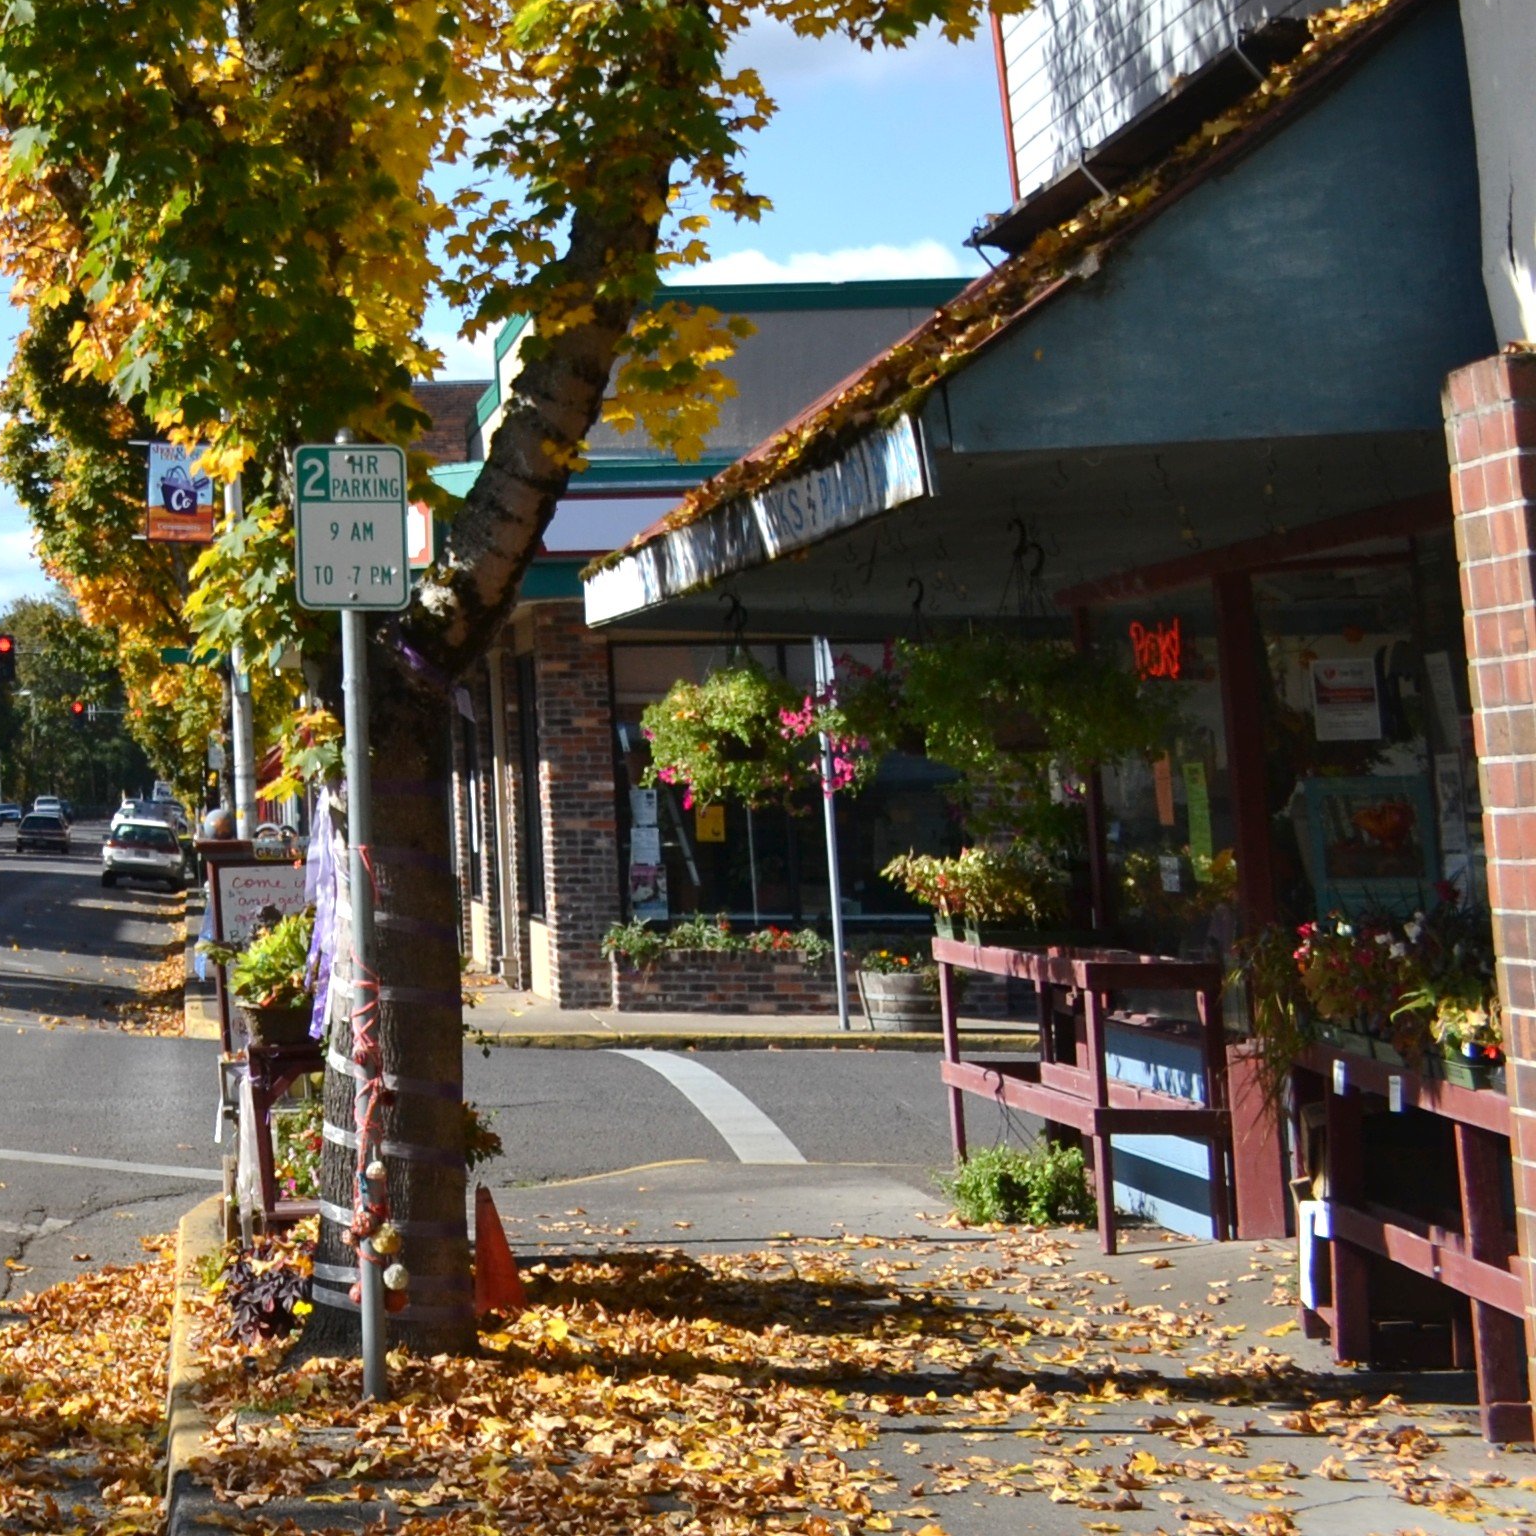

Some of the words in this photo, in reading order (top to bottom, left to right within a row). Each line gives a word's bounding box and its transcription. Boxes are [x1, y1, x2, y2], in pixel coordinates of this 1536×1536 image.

[302, 457, 326, 497] 2
[352, 455, 378, 475] HR
[332, 478, 399, 498] PARKING
[330, 522, 339, 541] 9
[351, 522, 374, 541] AM
[314, 566, 334, 585] TO
[352, 566, 361, 585] 7
[371, 566, 392, 586] PM
[238, 892, 270, 906] and
